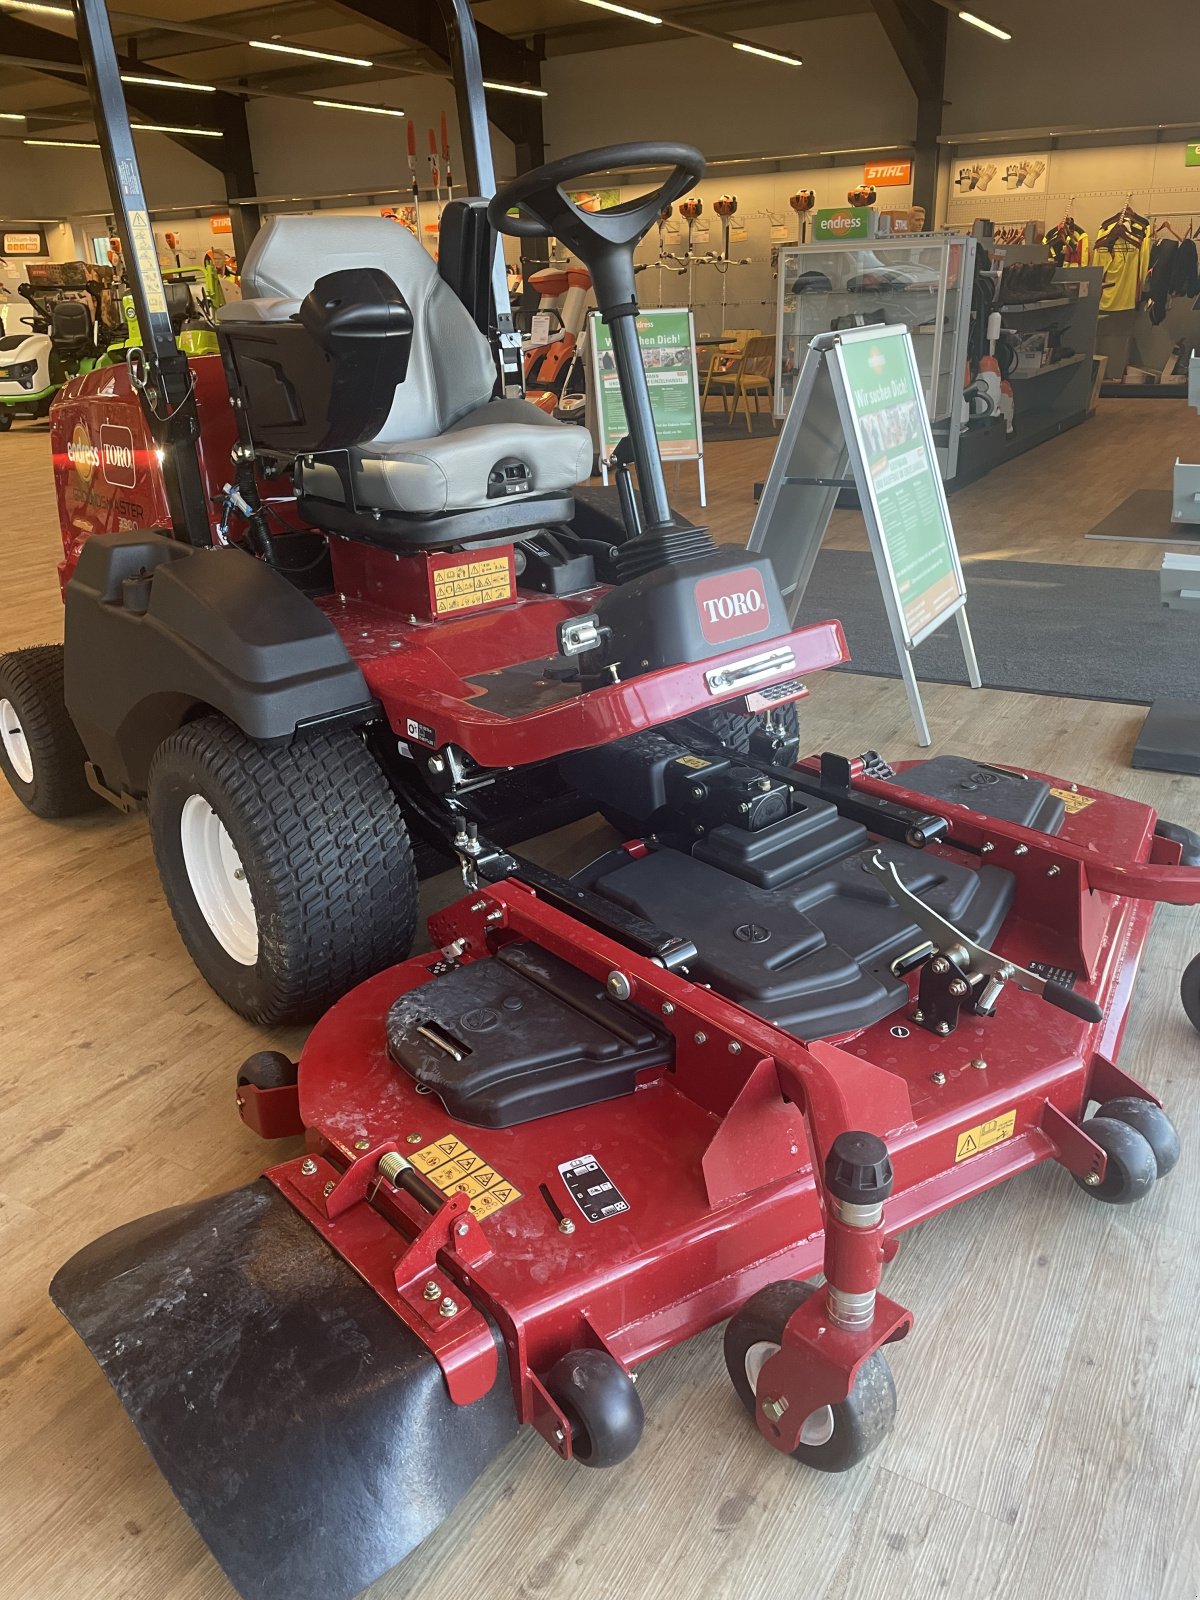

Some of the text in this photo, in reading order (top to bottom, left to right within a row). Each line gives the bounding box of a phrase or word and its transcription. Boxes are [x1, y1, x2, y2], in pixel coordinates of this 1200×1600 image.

[868, 167, 904, 178] STIHL
[820, 216, 861, 230] endress
[658, 334, 680, 344] Dich!
[855, 379, 909, 408] Wir suchen Dich!
[67, 437, 99, 466] endress
[103, 444, 131, 468] TORO
[703, 589, 762, 623] TORO
